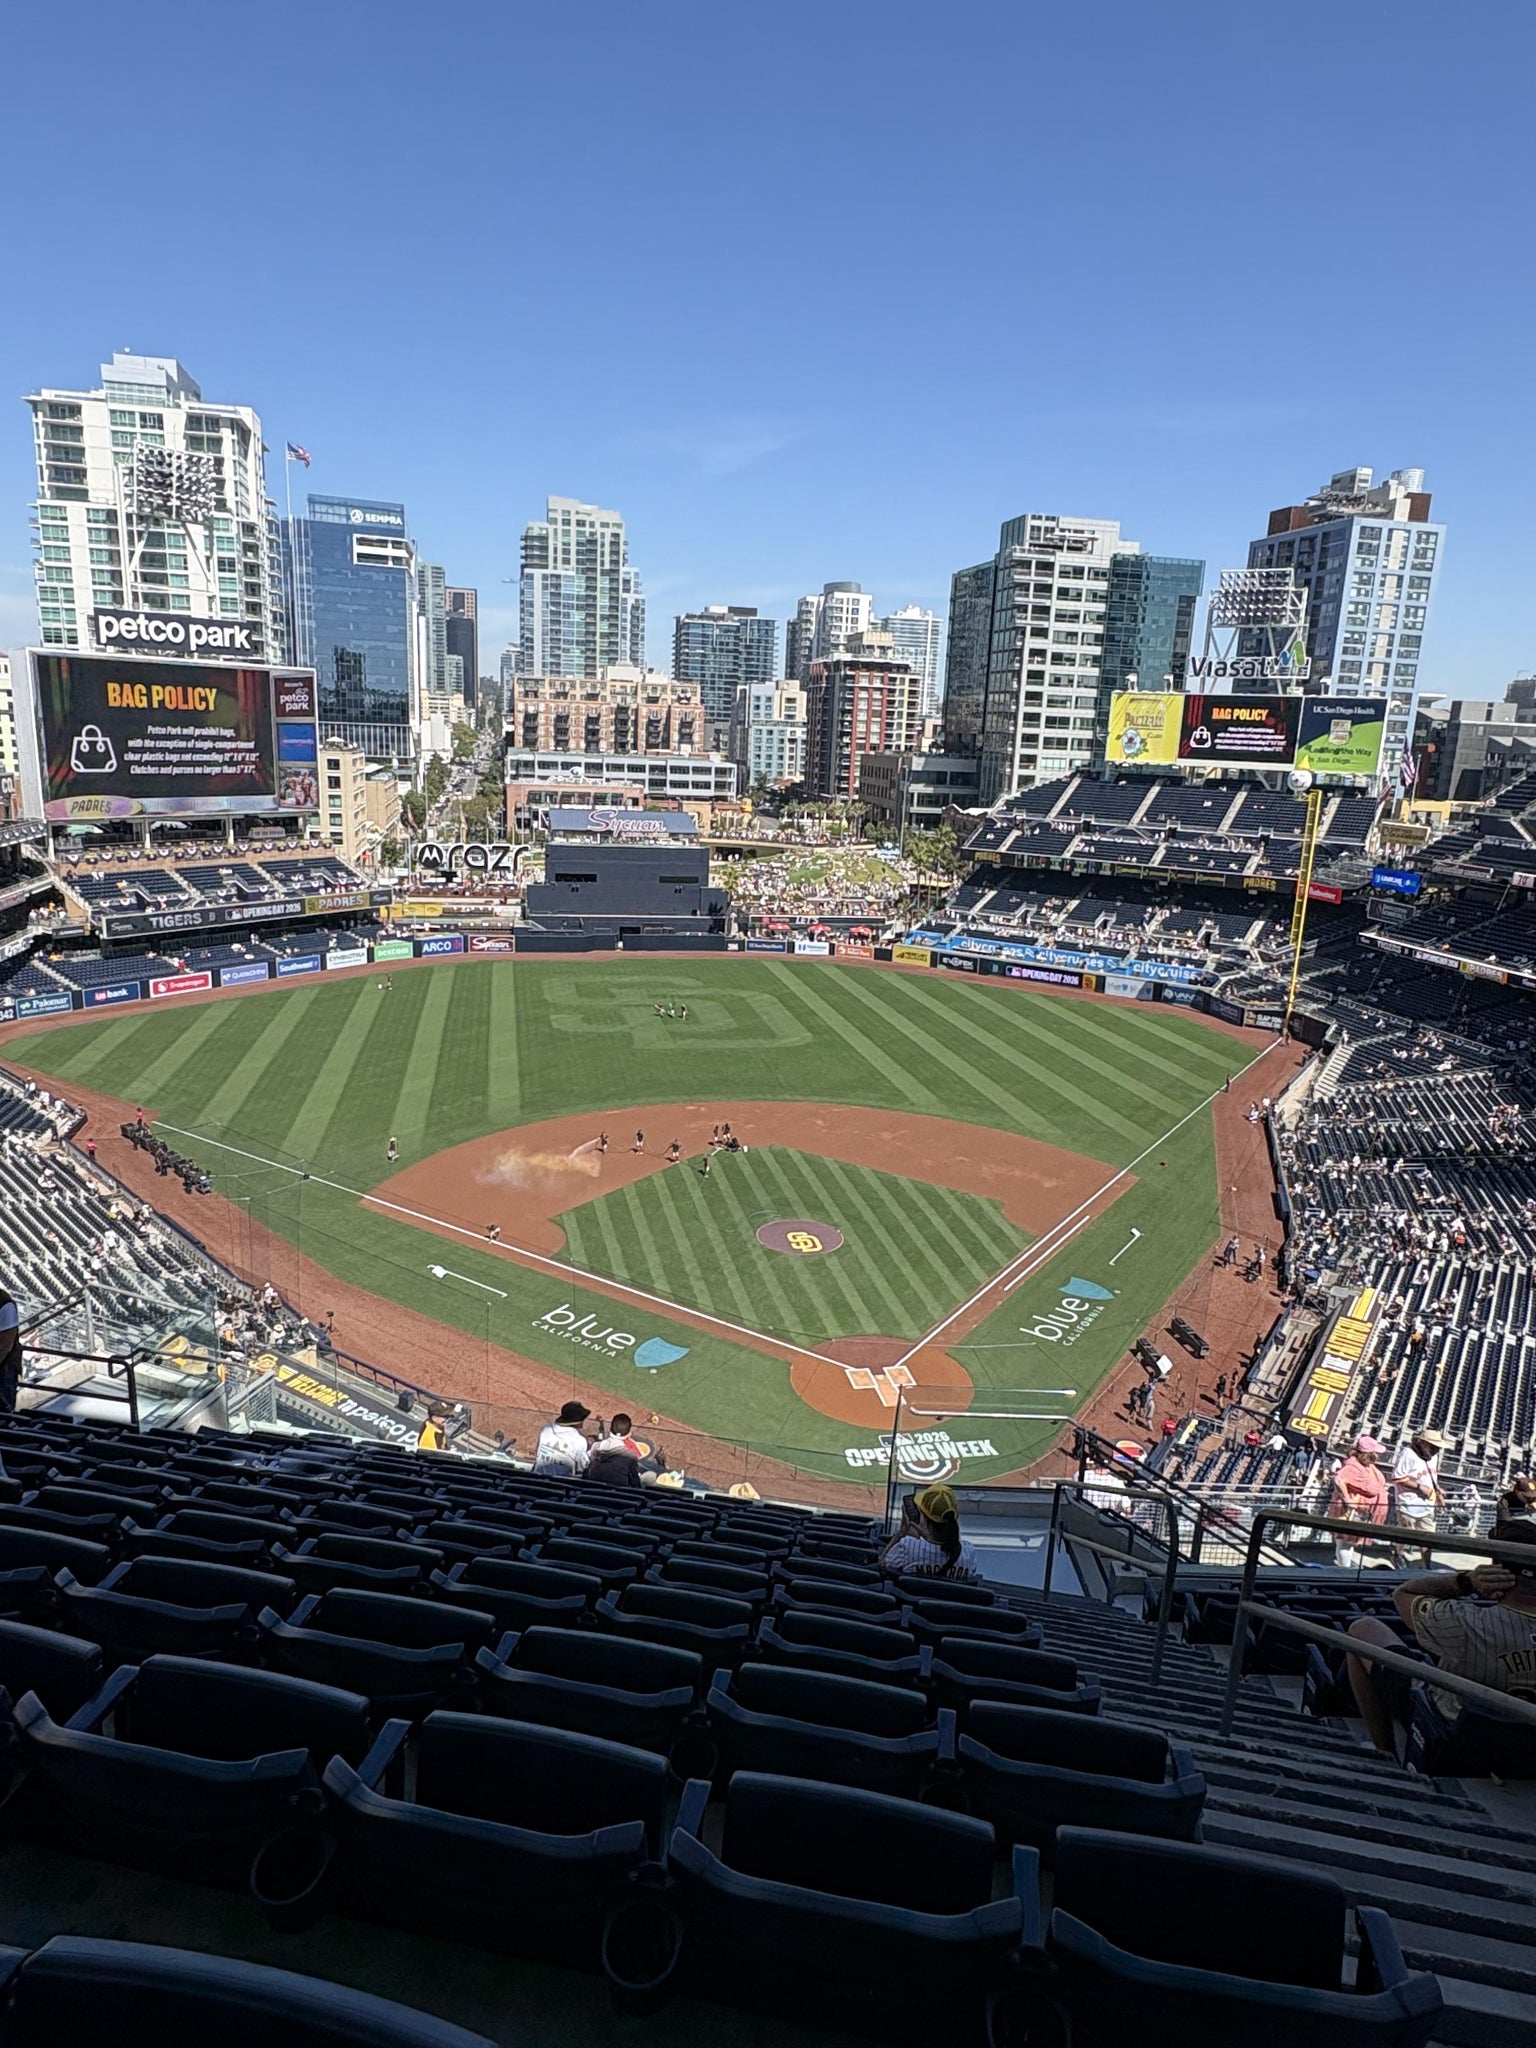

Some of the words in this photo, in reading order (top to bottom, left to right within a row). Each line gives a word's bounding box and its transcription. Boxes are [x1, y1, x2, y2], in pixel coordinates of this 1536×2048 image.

[365, 513, 403, 525] SEMPRA
[98, 614, 185, 644] petco
[189, 624, 252, 651] park
[1191, 656, 1269, 678] Viasat
[106, 682, 148, 709] BAG
[151, 685, 217, 711] POLICY
[280, 693, 309, 704] petco
[285, 702, 309, 712] park
[1212, 707, 1232, 720] BAG
[1233, 708, 1269, 721] POLICY
[143, 739, 155, 748] the
[1355, 748, 1373, 757] Way
[2, 778, 16, 793] CO.
[71, 799, 112, 814] PADRES
[587, 809, 667, 837] Sycuan
[447, 843, 529, 873] razr
[974, 851, 1000, 865] PADRES
[1243, 876, 1277, 891] PADRES
[319, 895, 364, 909] PADRES
[149, 913, 203, 928] TIGERS
[423, 940, 452, 953] ARCO
[107, 988, 129, 998] bank
[32, 996, 69, 1009] Palomar
[540, 1303, 636, 1350] blue
[1019, 1297, 1090, 1342] blue
[1062, 1305, 1105, 1347] CALIFORNIA
[531, 1320, 617, 1358] CALIFORNIA
[345, 1406, 407, 1437] petco
[914, 1431, 950, 1444] 2026
[935, 1439, 1000, 1459] WEEK
